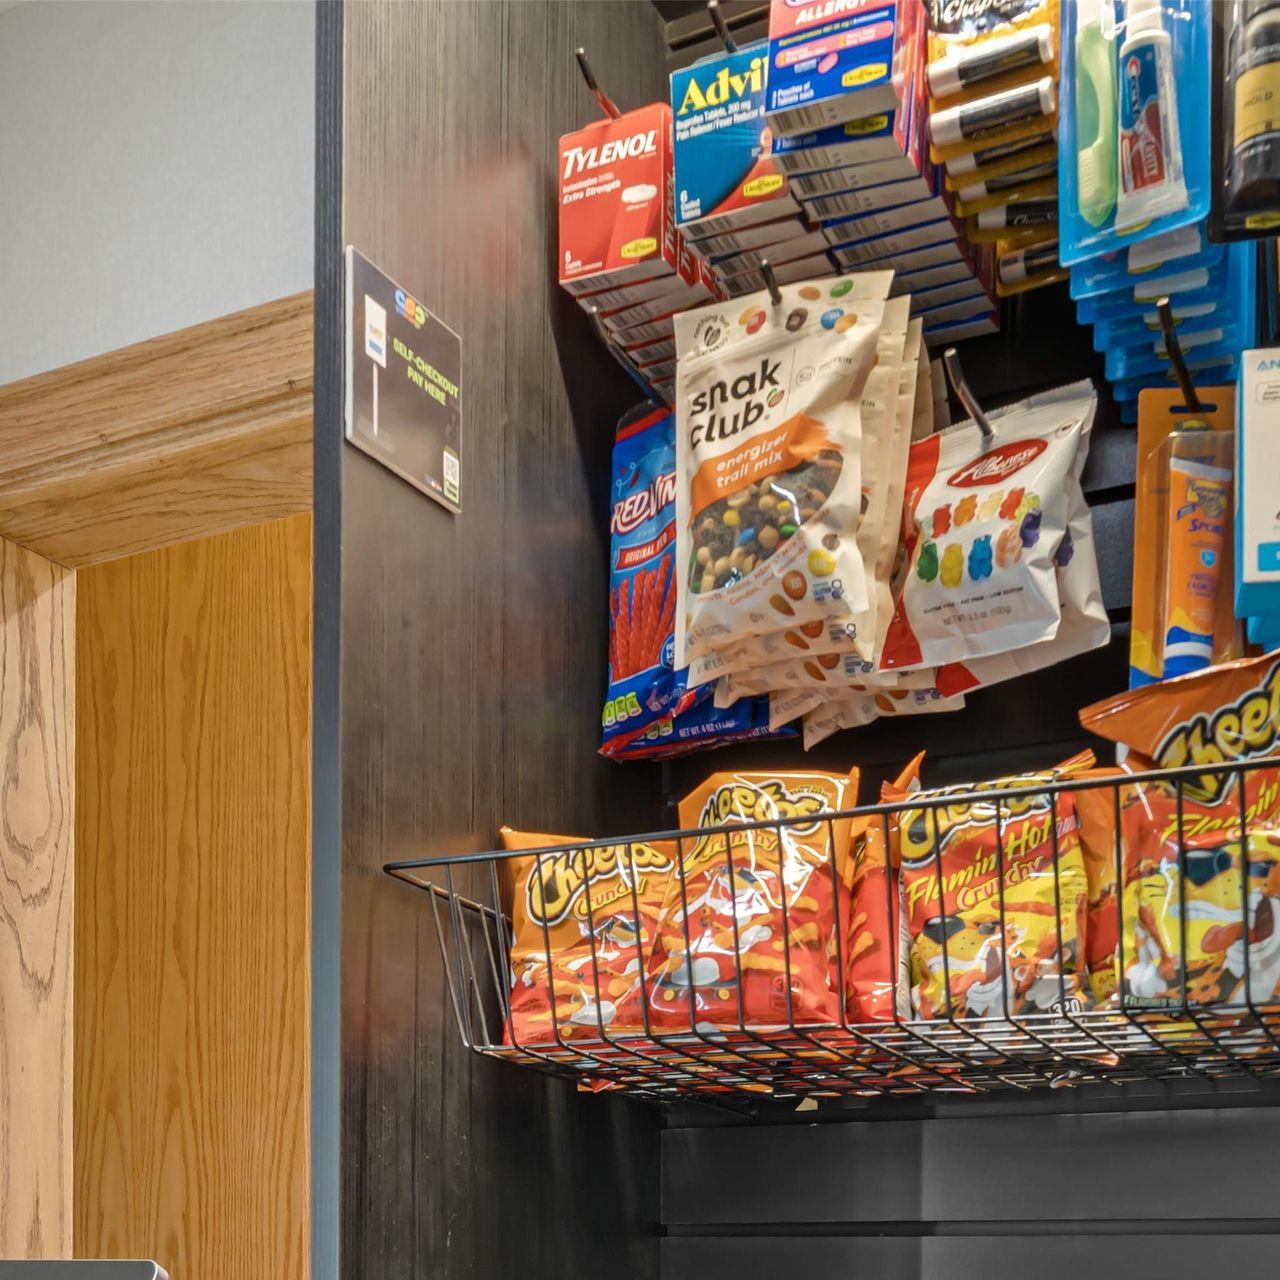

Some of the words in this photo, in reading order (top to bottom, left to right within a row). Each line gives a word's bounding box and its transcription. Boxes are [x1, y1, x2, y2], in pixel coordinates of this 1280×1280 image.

[562, 130, 657, 180] TYLENOL
[392, 337, 459, 399] SELF-CHECKOUT
[407, 366, 423, 389] PAY
[424, 378, 446, 407] HERE
[691, 359, 782, 417] snak
[690, 400, 764, 449] club
[716, 431, 788, 472] energizer
[716, 463, 751, 487] trail
[753, 452, 782, 471] mix
[906, 845, 998, 923] Flamin
[1006, 819, 1052, 860] Hot
